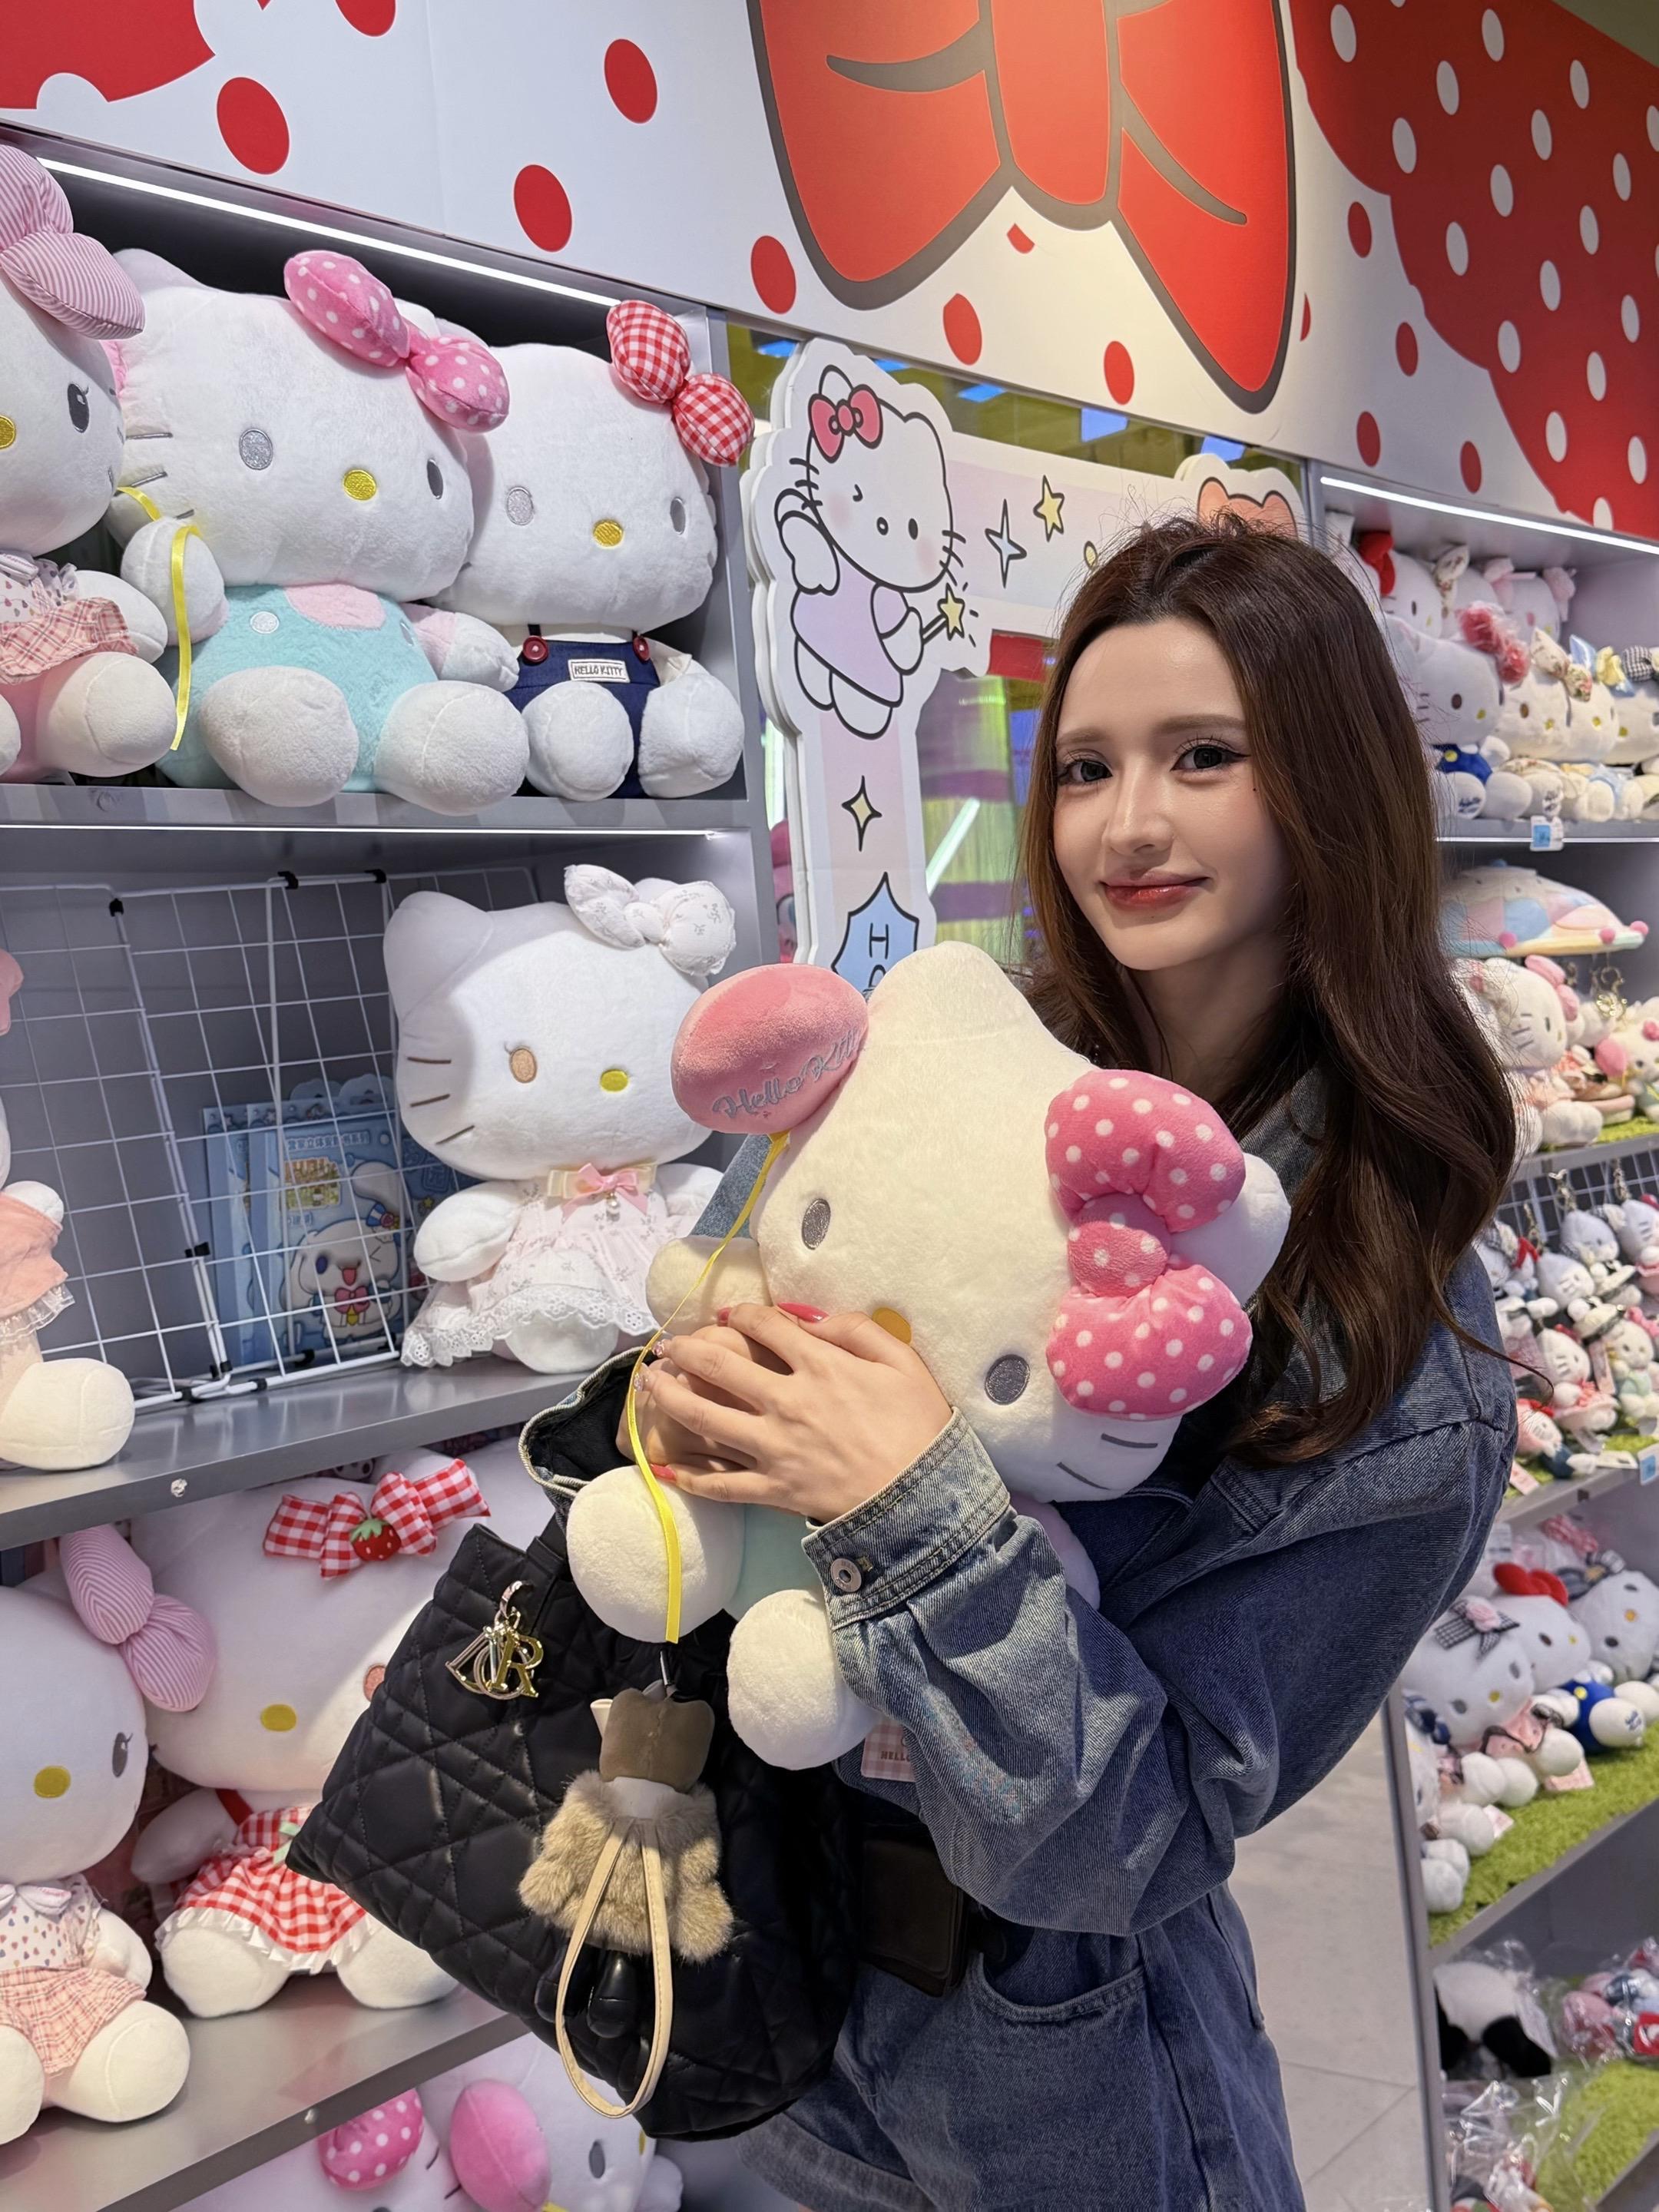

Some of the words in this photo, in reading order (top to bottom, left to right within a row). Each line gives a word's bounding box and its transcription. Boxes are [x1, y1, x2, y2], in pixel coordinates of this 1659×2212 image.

[575, 664, 598, 675] HELLO
[600, 665, 623, 677] KITTY
[712, 1075, 803, 1119] Hello
[803, 1026, 860, 1082] Kitt
